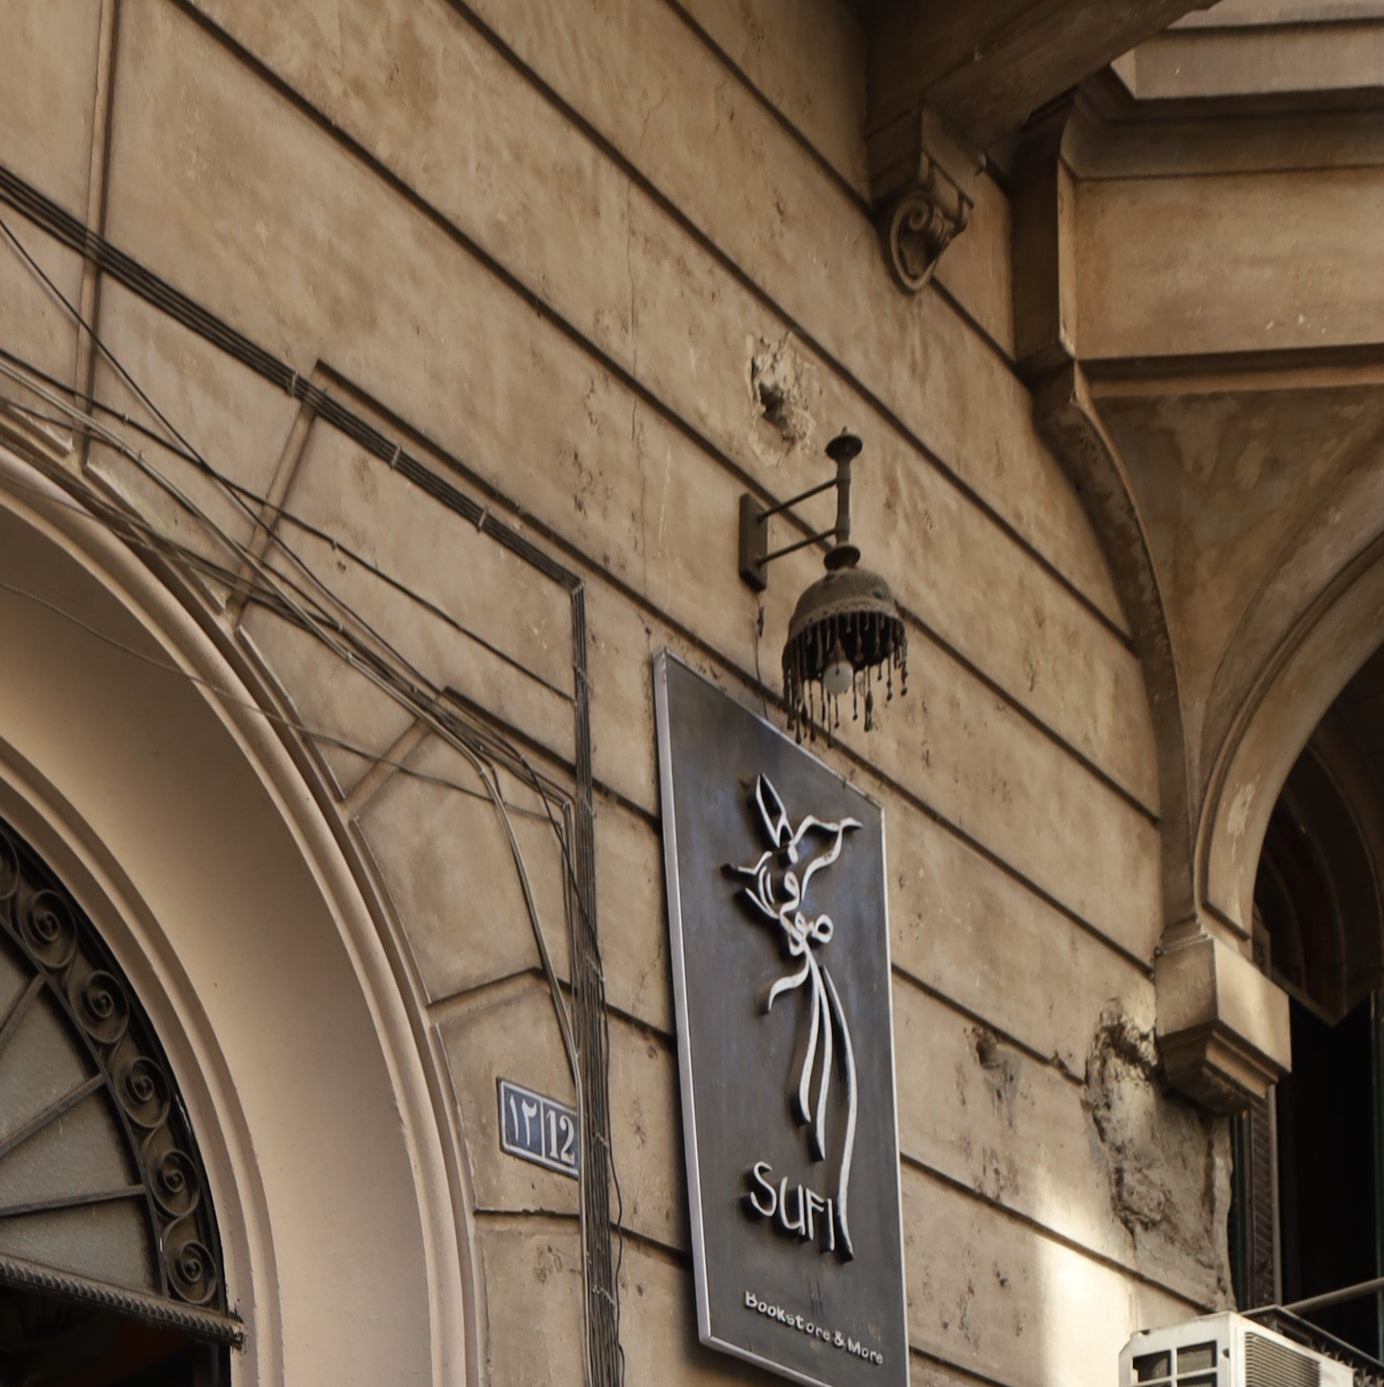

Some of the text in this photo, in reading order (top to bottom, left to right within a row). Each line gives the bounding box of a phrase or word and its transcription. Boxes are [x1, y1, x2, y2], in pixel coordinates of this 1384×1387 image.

[509, 1094, 537, 1147] ١٢
[546, 1109, 575, 1166] 12
[744, 1290, 884, 1365] Bookstore & More
